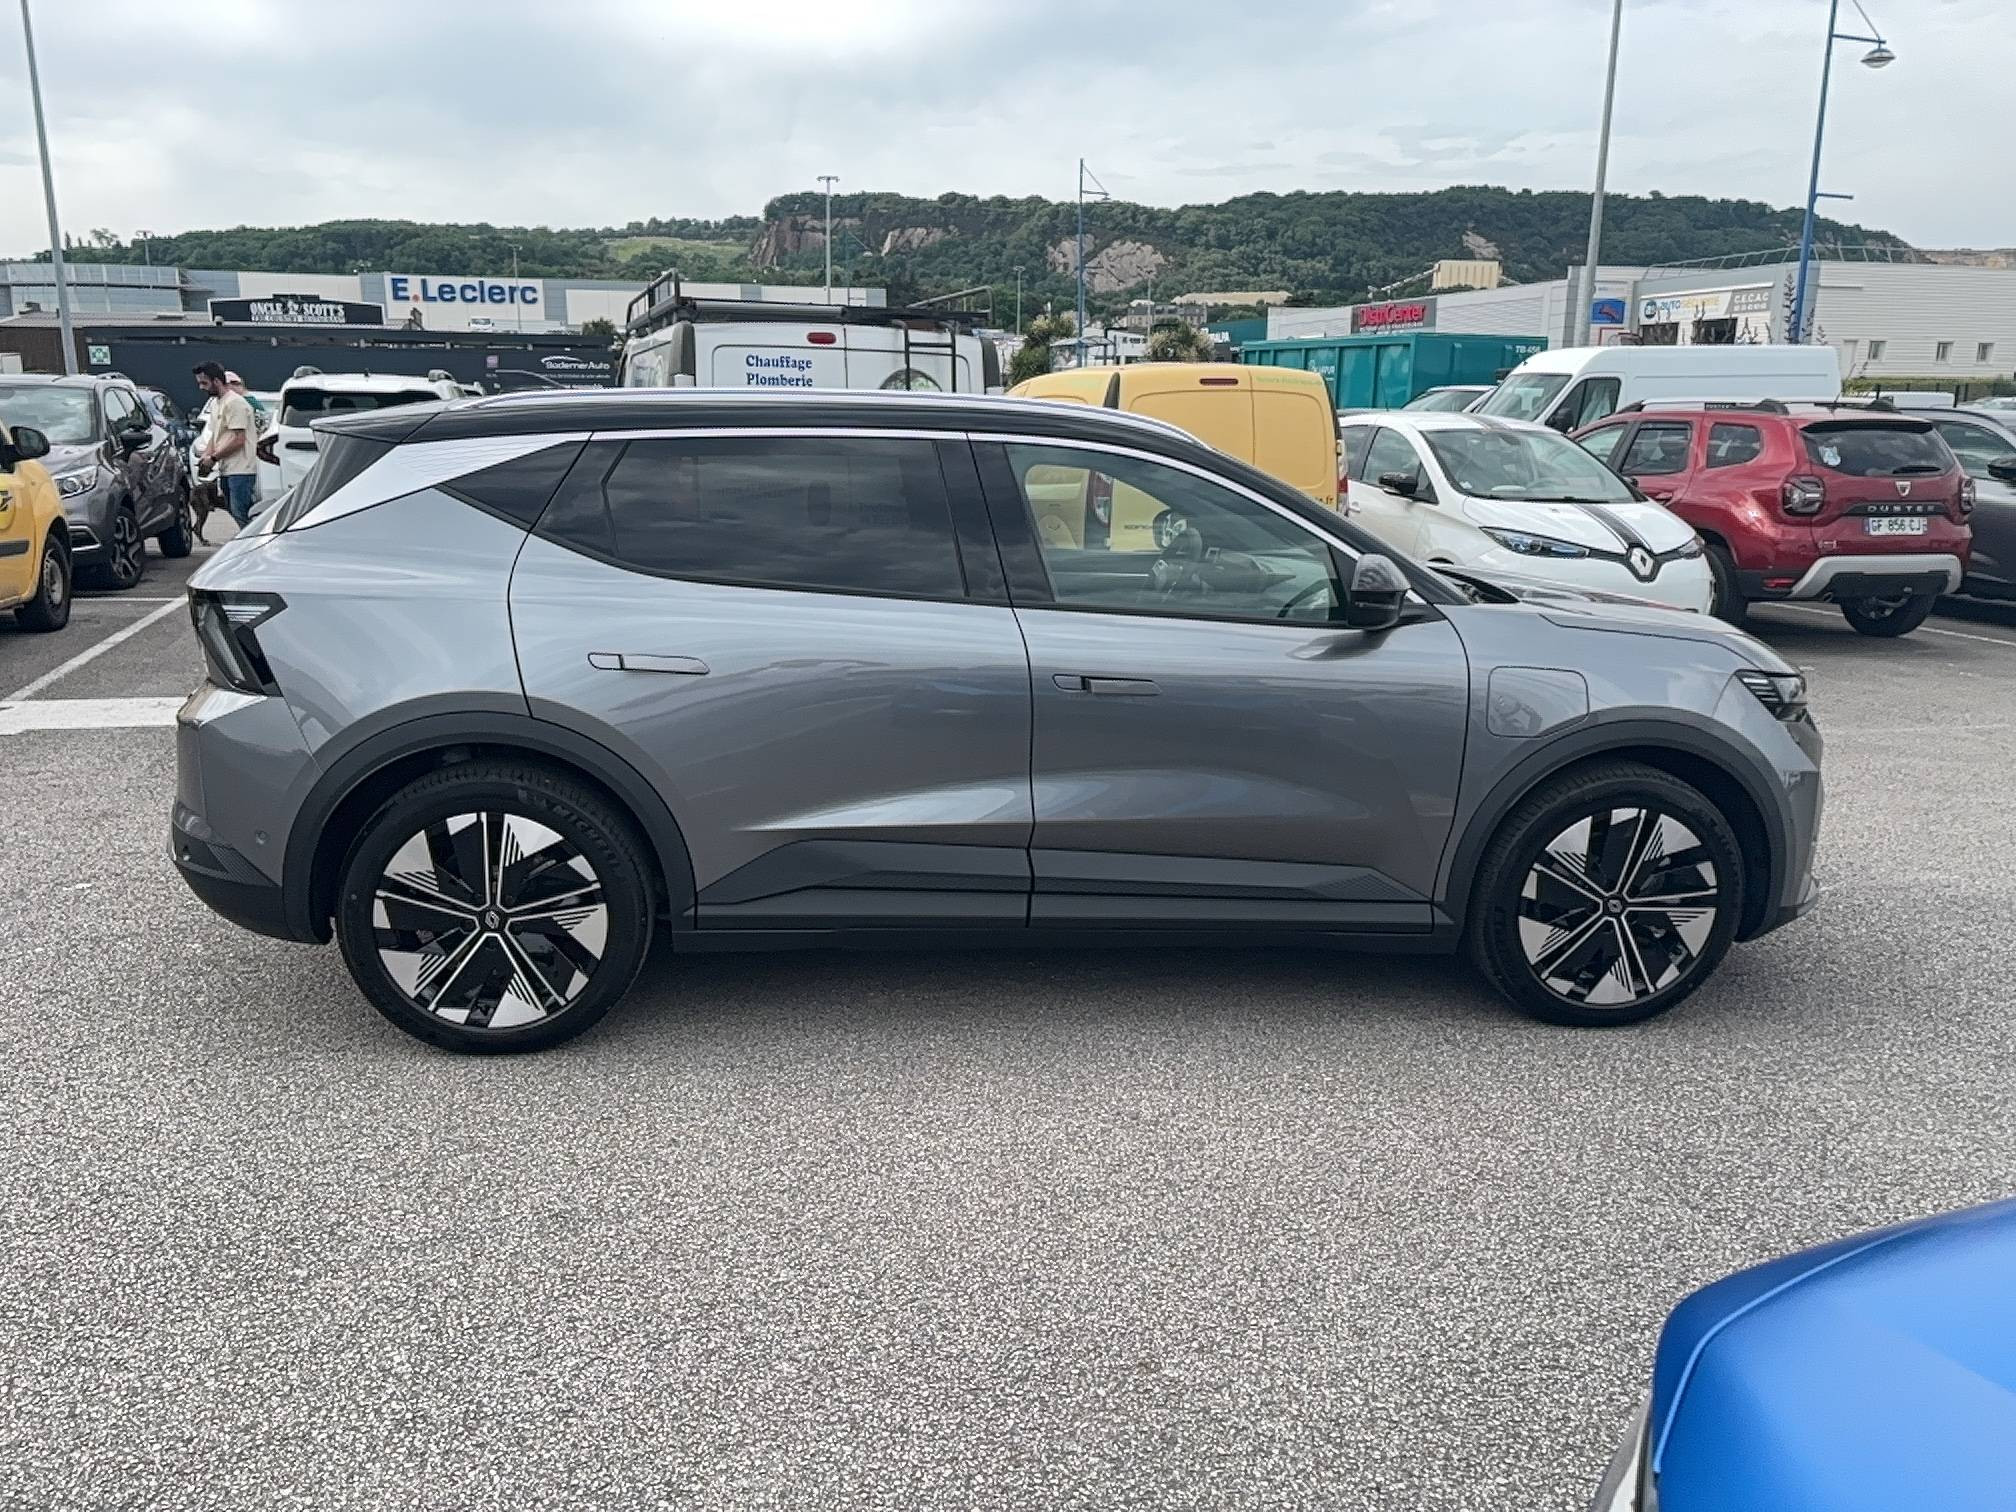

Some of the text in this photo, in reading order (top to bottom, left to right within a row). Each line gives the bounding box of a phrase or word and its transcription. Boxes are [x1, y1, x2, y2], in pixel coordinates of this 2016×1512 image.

[391, 277, 538, 304] E.Leclerc
[745, 354, 813, 372] Chauffage
[746, 372, 813, 387] Plomberie
